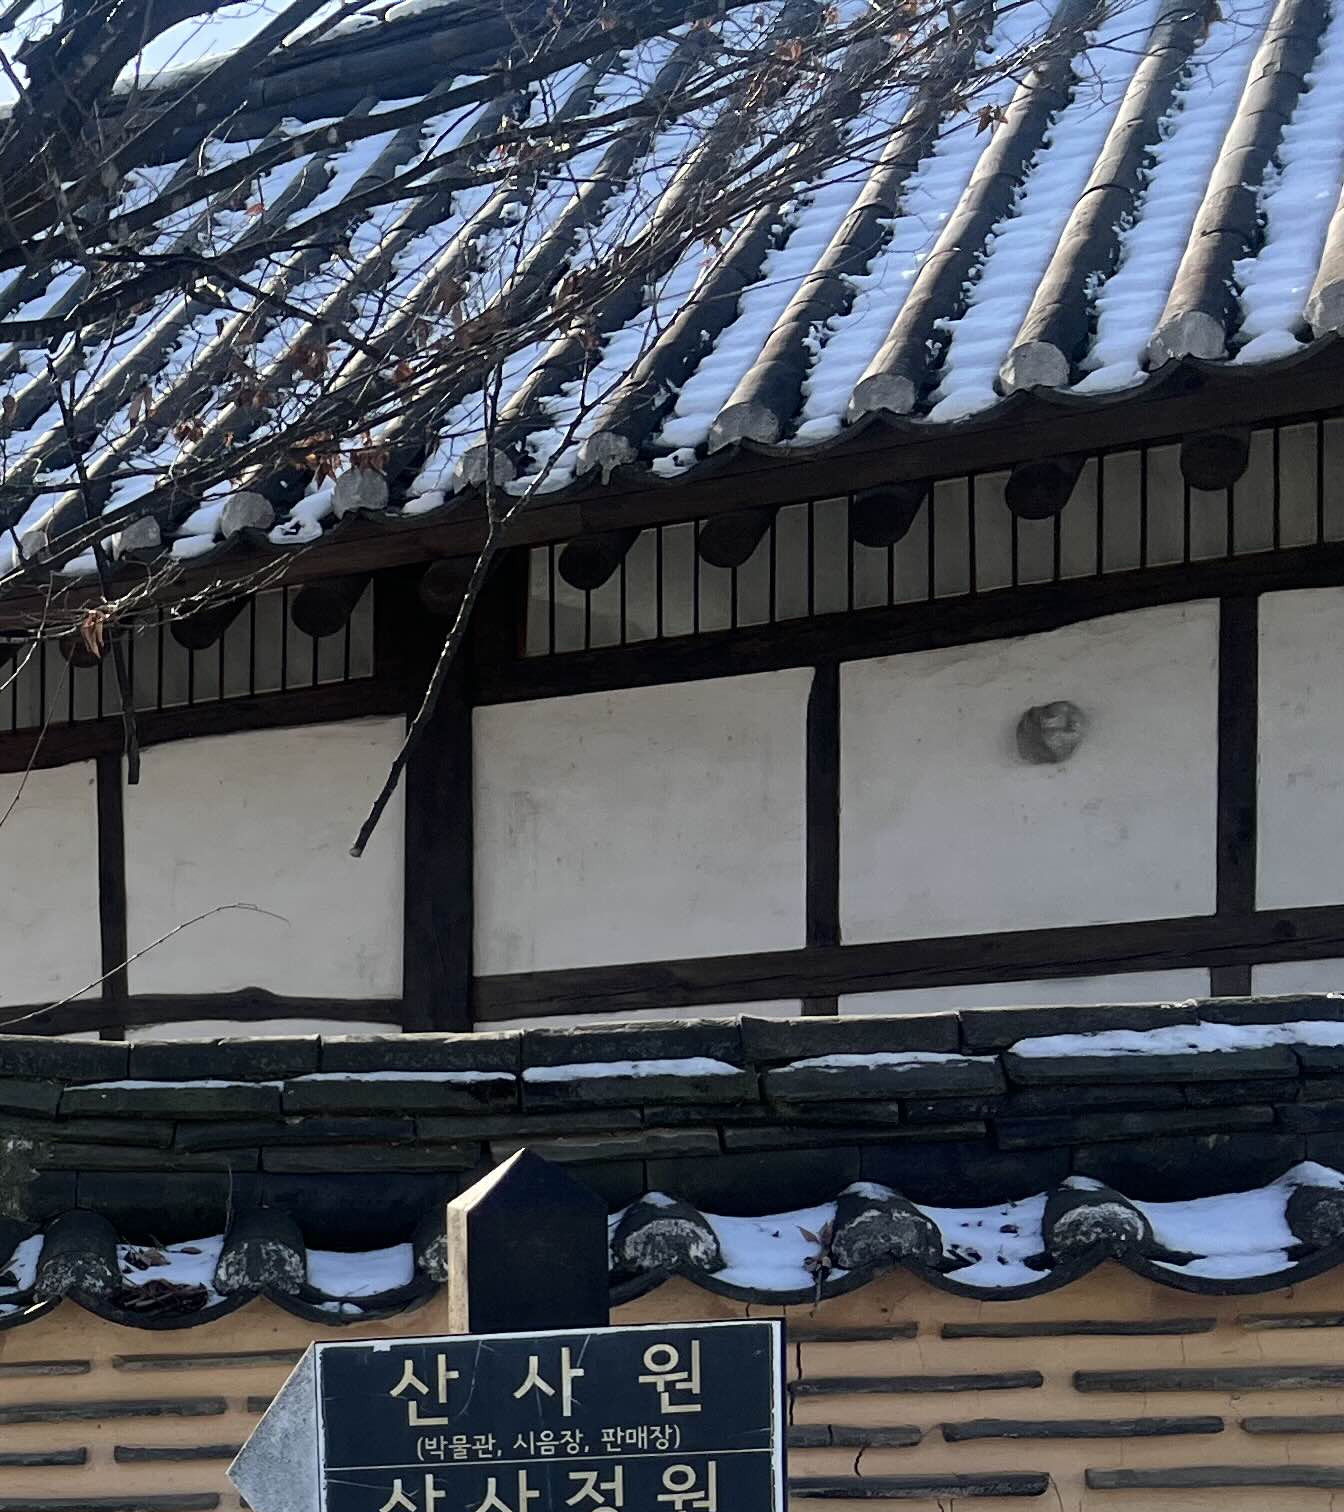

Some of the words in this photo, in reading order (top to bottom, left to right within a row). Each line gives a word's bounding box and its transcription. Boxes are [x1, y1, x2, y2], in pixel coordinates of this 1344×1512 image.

[416, 1434, 502, 1461] (박물관,
[512, 1429, 590, 1456] 시음장,
[600, 1424, 682, 1452] 판매장)
